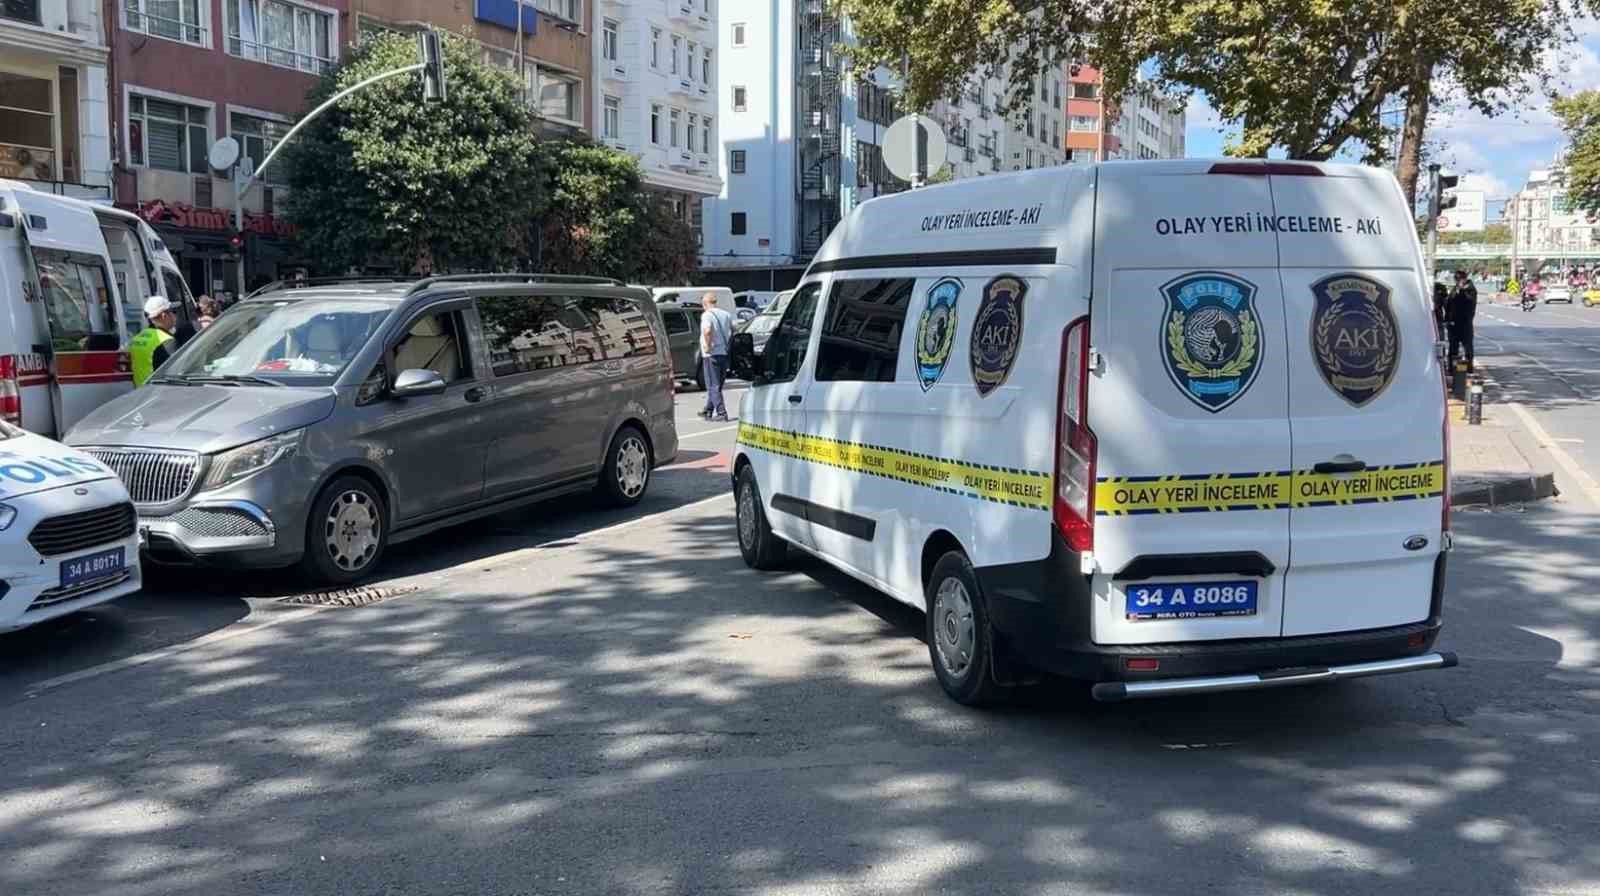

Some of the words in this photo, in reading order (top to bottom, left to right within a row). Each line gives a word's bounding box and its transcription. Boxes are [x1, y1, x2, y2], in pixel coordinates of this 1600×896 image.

[921, 215, 944, 231] OLAY
[964, 207, 1014, 228] İNCELEME
[1019, 203, 1043, 224] AKİ
[1156, 217, 1207, 235] OLAY
[1211, 212, 1253, 233] YERİ
[1256, 212, 1343, 233] İNCELEME
[1356, 216, 1383, 235] AKİ
[0, 455, 104, 485] OLİS
[964, 475, 983, 488] OLAY
[1301, 480, 1340, 497] OLAY
[1344, 474, 1372, 494] YERİ
[1375, 473, 1433, 491] İNCELEME
[1114, 488, 1160, 504] OLAY
[1165, 483, 1199, 502] YERİ
[1203, 483, 1279, 501] İNCELEME
[69, 564, 81, 577] 34
[84, 558, 91, 572] A
[1136, 589, 1163, 606] 34
[1170, 588, 1186, 605] A
[1193, 586, 1248, 604] 8086
